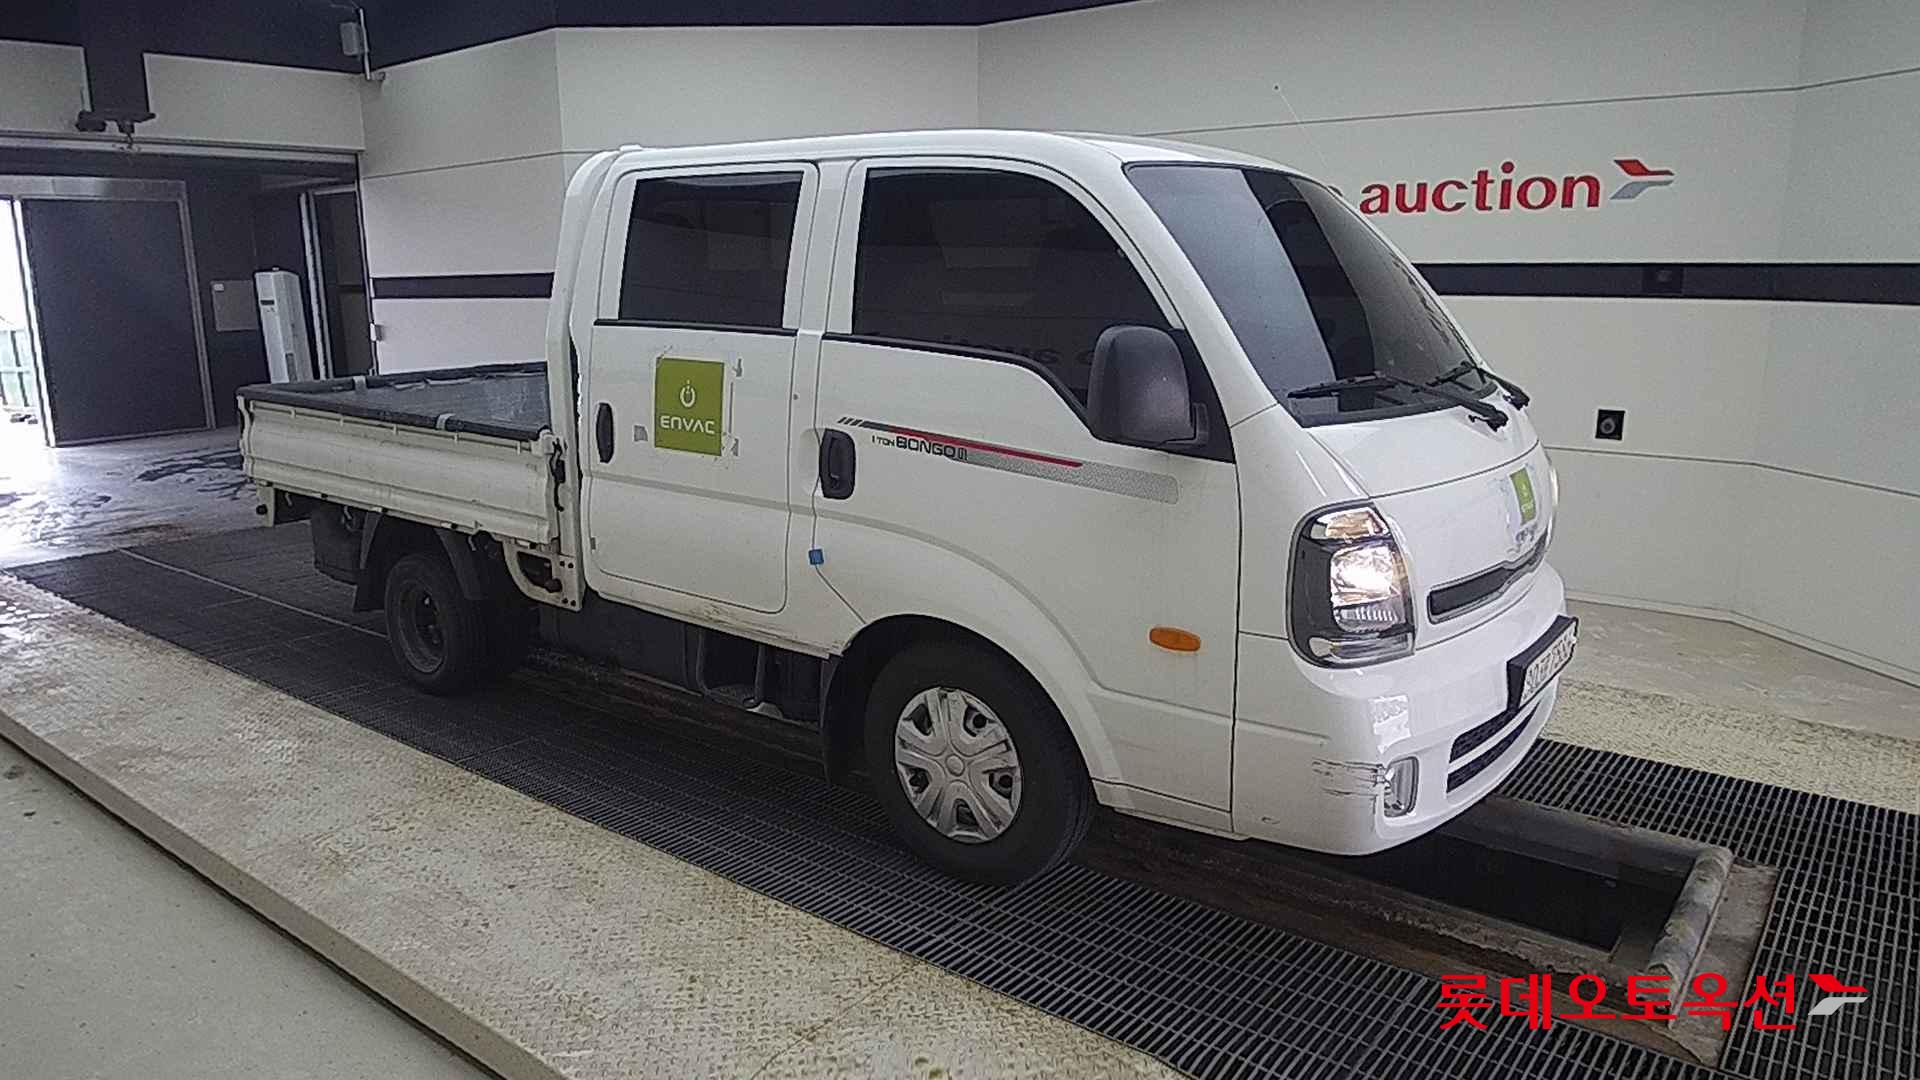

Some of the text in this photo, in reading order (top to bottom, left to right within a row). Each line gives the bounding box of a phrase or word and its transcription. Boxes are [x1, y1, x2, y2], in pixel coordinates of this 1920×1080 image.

[1359, 161, 1601, 214] auction
[660, 415, 715, 435] ENVAC
[877, 437, 895, 447] TON
[896, 436, 955, 457] BONGO
